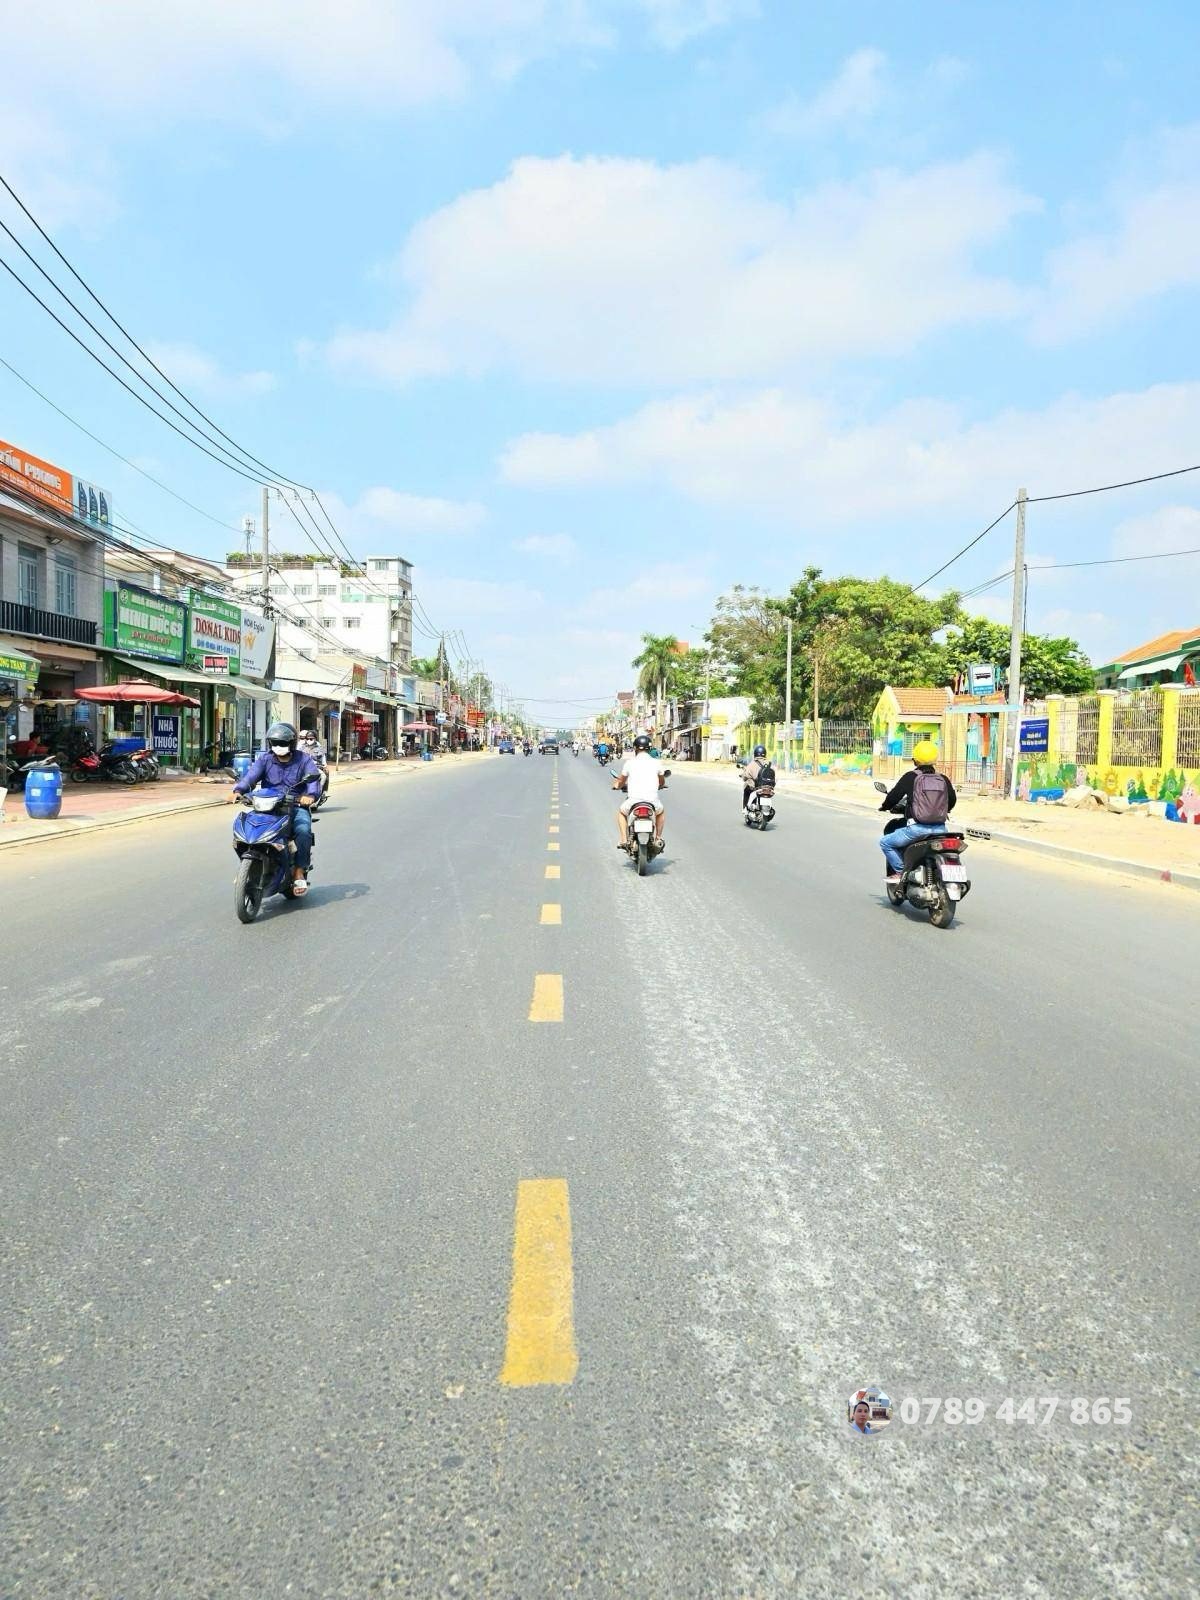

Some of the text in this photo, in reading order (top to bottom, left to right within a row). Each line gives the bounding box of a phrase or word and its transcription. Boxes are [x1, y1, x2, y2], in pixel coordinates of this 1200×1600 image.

[195, 617, 223, 639] DONAL
[224, 626, 241, 645] KIDS
[154, 732, 178, 749] THUỐC
